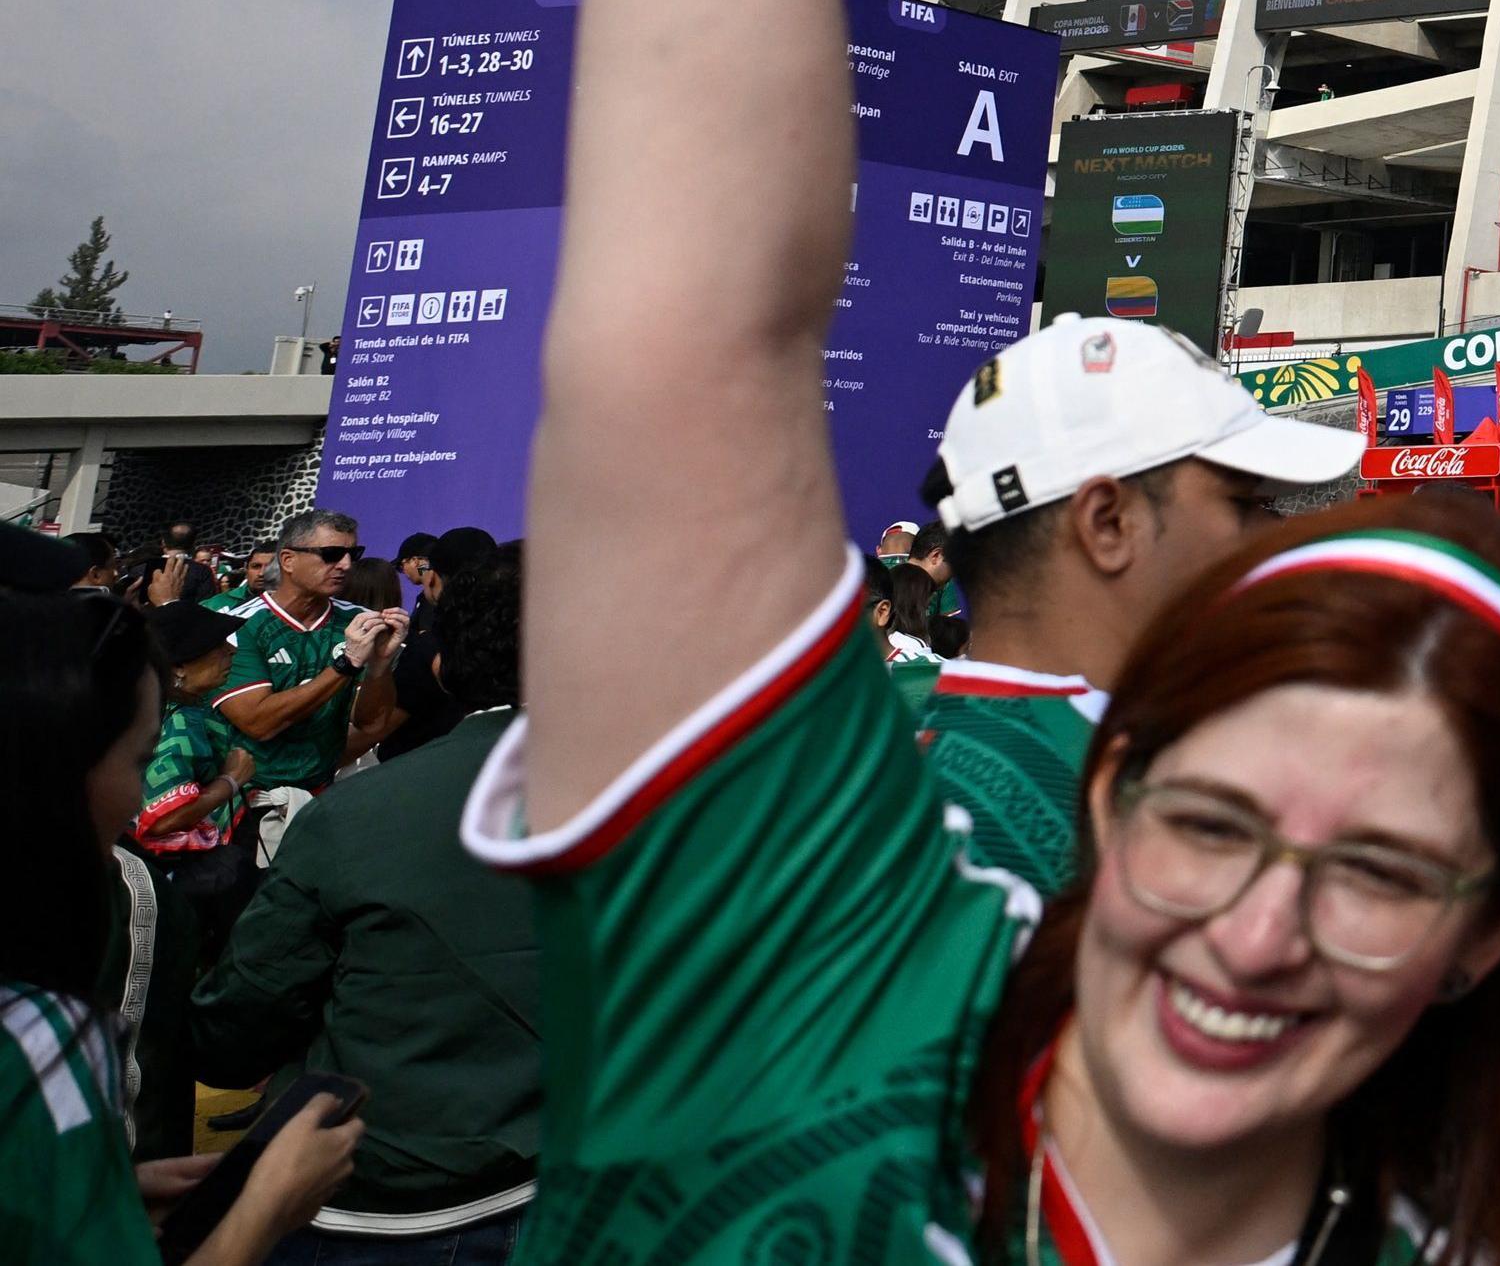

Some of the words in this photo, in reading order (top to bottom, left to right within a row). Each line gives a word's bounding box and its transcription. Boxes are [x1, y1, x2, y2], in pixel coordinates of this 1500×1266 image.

[901, 1, 935, 23] FIFA
[442, 34, 490, 47] TÚNELES
[494, 30, 540, 43] TUNNELS
[857, 62, 890, 79] Bridge
[958, 61, 995, 79] SALIDA
[999, 70, 1019, 84] EXIT
[432, 93, 481, 106] TÚNELES
[485, 90, 532, 103] TUNNELS
[957, 89, 1004, 162] A
[1103, 147, 1118, 155] FIFA
[1160, 144, 1185, 152] 2026
[423, 154, 468, 167] RAMPAS
[472, 151, 507, 164] RAMPS
[1074, 157, 1131, 174] NEXT
[1135, 153, 1212, 169] MATCH
[941, 236, 966, 248] Salida
[982, 242, 992, 251] Av
[994, 244, 1005, 253] del
[1008, 246, 1026, 256] Imán
[953, 252, 966, 261] Exit
[981, 255, 992, 264] Del
[960, 274, 1023, 290] Estacionamiento
[393, 302, 409, 310] FIFA
[996, 292, 1021, 306] Parking
[960, 310, 975, 319] Taxi
[985, 313, 1019, 324] vehículos
[936, 323, 987, 334] compartidos
[989, 327, 1017, 338] Cantera
[355, 338, 385, 349] Tienda
[389, 336, 418, 347] oficial
[421, 336, 434, 345] de
[436, 335, 445, 344] la
[448, 334, 469, 344] FIFA
[918, 333, 932, 343] Taxi
[943, 336, 959, 346] Ride
[962, 338, 988, 351] Sharing
[352, 354, 368, 364] FIFA
[372, 353, 394, 363] Store
[347, 376, 373, 388] Salón
[377, 376, 389, 386] B2
[834, 379, 864, 391] Acoxpa
[345, 392, 376, 404] Lounge
[379, 391, 391, 401] B2
[341, 416, 369, 427] Zonas
[372, 414, 384, 424] de
[387, 412, 439, 428] hospitality
[1389, 409, 1410, 431] 29
[339, 430, 385, 443] Hospitality
[387, 428, 417, 440] Village
[335, 455, 366, 466] Centro
[369, 454, 391, 466] para
[395, 451, 456, 464] trabajadores
[333, 470, 374, 482] Workforce
[378, 468, 407, 478] Center
